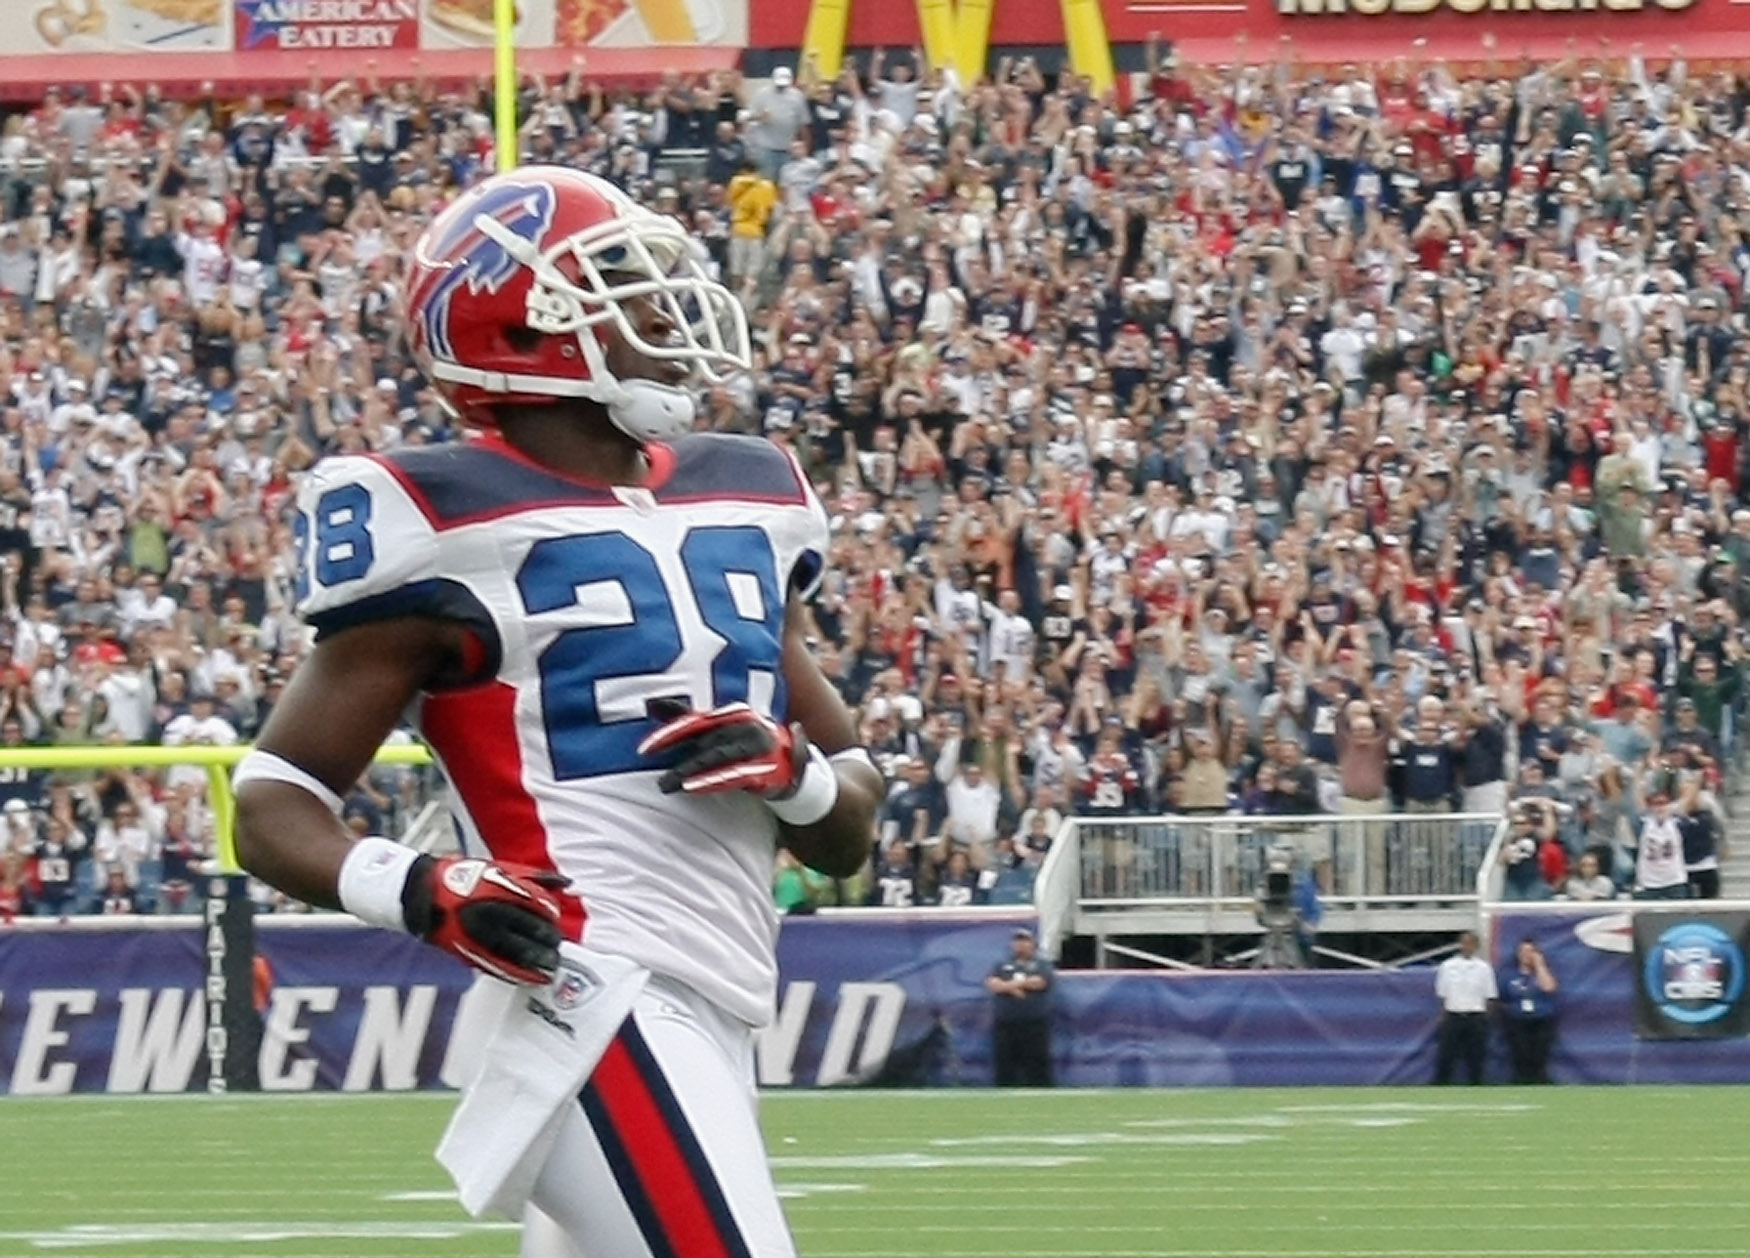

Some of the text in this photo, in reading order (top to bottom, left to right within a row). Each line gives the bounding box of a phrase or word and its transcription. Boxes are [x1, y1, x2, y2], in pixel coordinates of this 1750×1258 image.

[279, 25, 399, 48] EATERY
[515, 525, 789, 781] 28
[0, 987, 206, 1093] EW
[207, 898, 228, 1092] PATRIOTS
